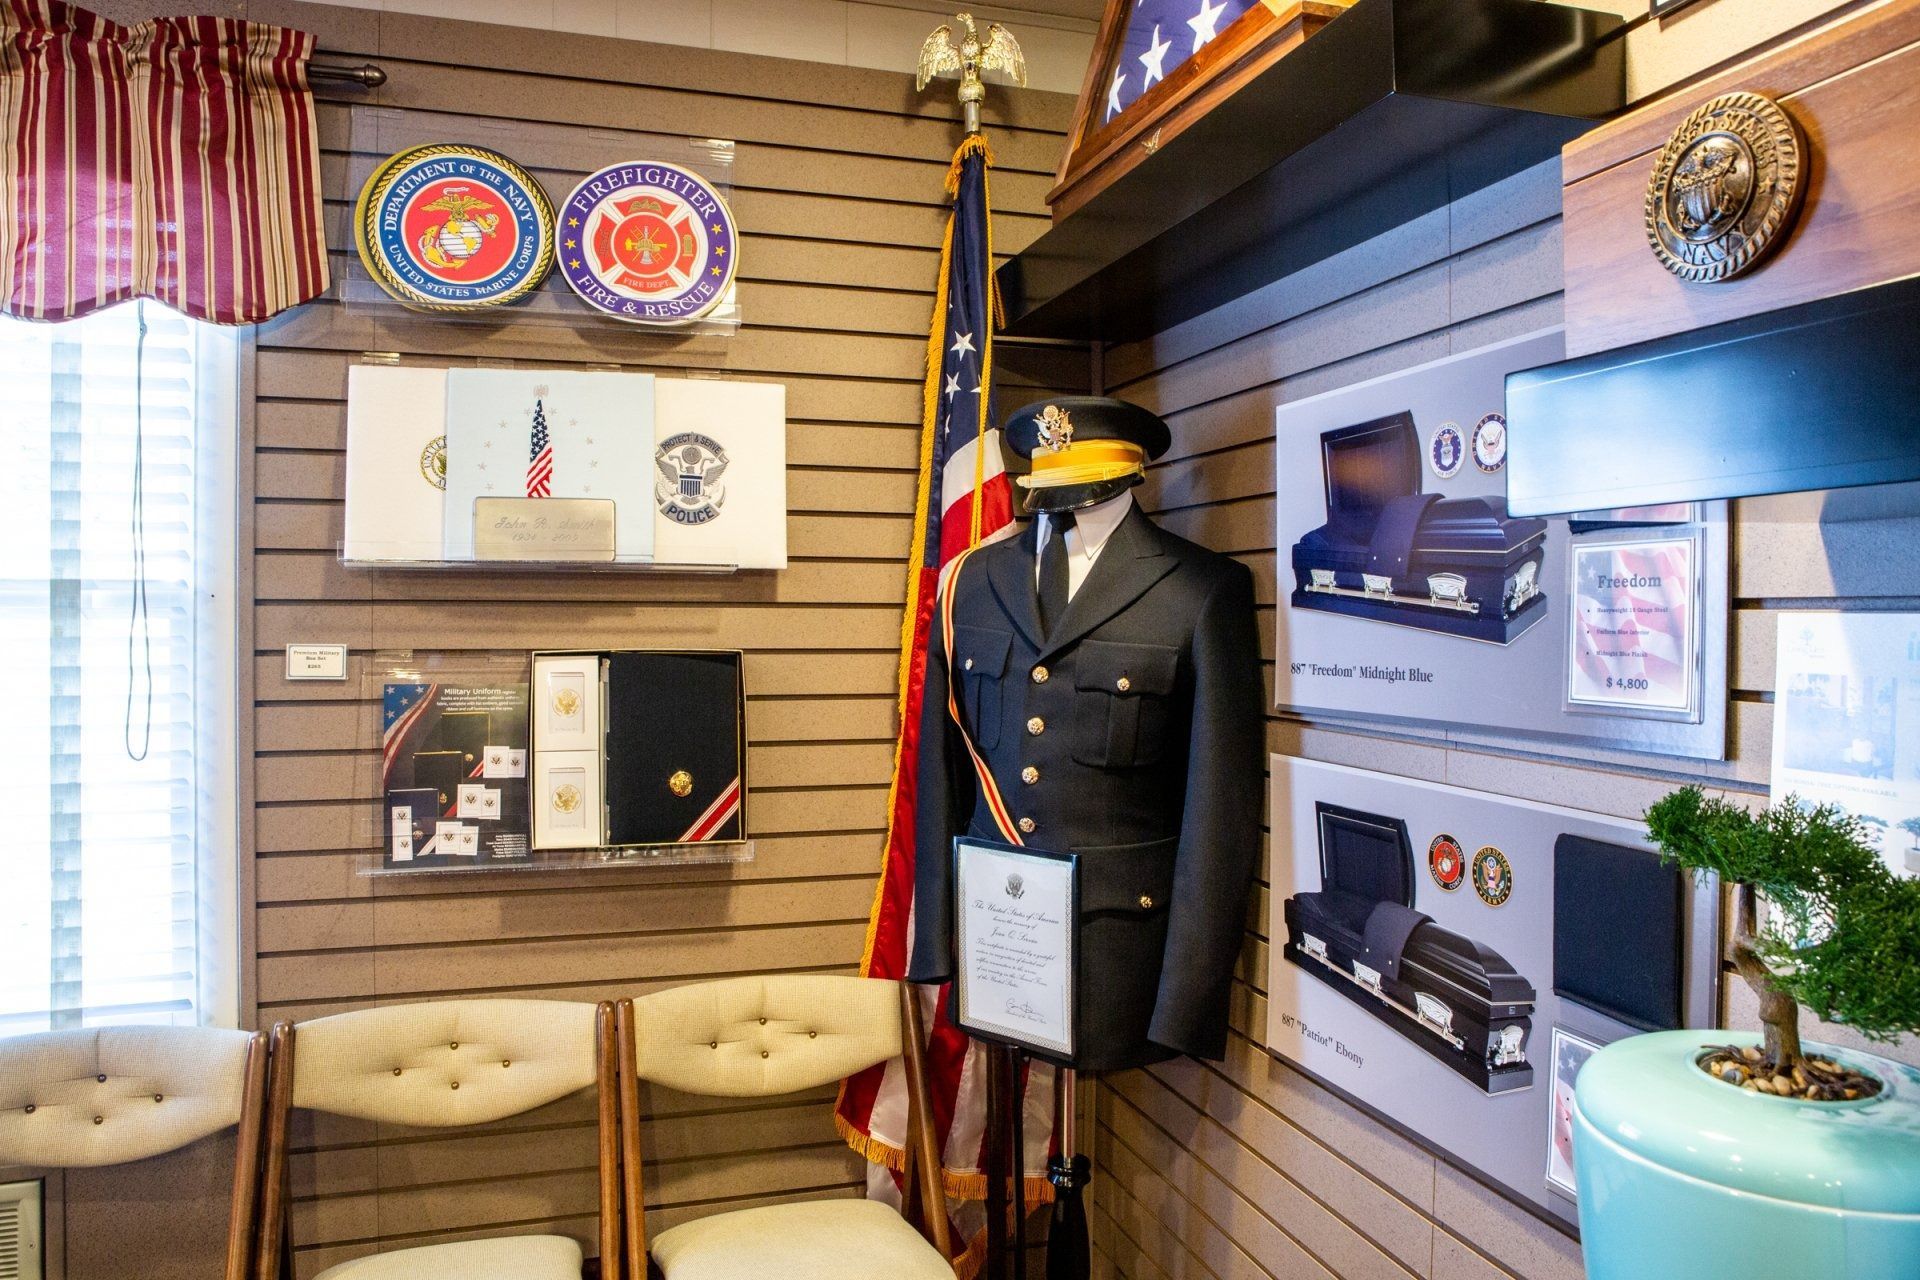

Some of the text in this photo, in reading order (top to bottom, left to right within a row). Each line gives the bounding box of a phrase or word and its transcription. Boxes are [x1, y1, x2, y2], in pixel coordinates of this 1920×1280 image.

[384, 162, 534, 231] DEPARTMENT OF THE NAVY
[572, 168, 717, 220] FIREFIGHTER
[389, 235, 534, 297] UNITED STATES MARINE CORPS
[623, 277, 644, 288] FIRE
[577, 274, 714, 317] FIRE & RESCUE
[661, 434, 691, 451] PROTECT
[700, 437, 722, 454] SERVE
[494, 516, 527, 529] John
[665, 504, 715, 523] POLICE
[1597, 574, 1662, 589] Freedom
[1290, 662, 1434, 684] 887 "Freedom" Midnight Blue
[444, 688, 471, 696] Military
[1606, 677, 1649, 690] $ 4,800
[1474, 847, 1510, 871] UNITED STATES
[1483, 894, 1502, 904] ARMY
[1281, 1013, 1364, 1069] 887 "Patriot" Ebony
